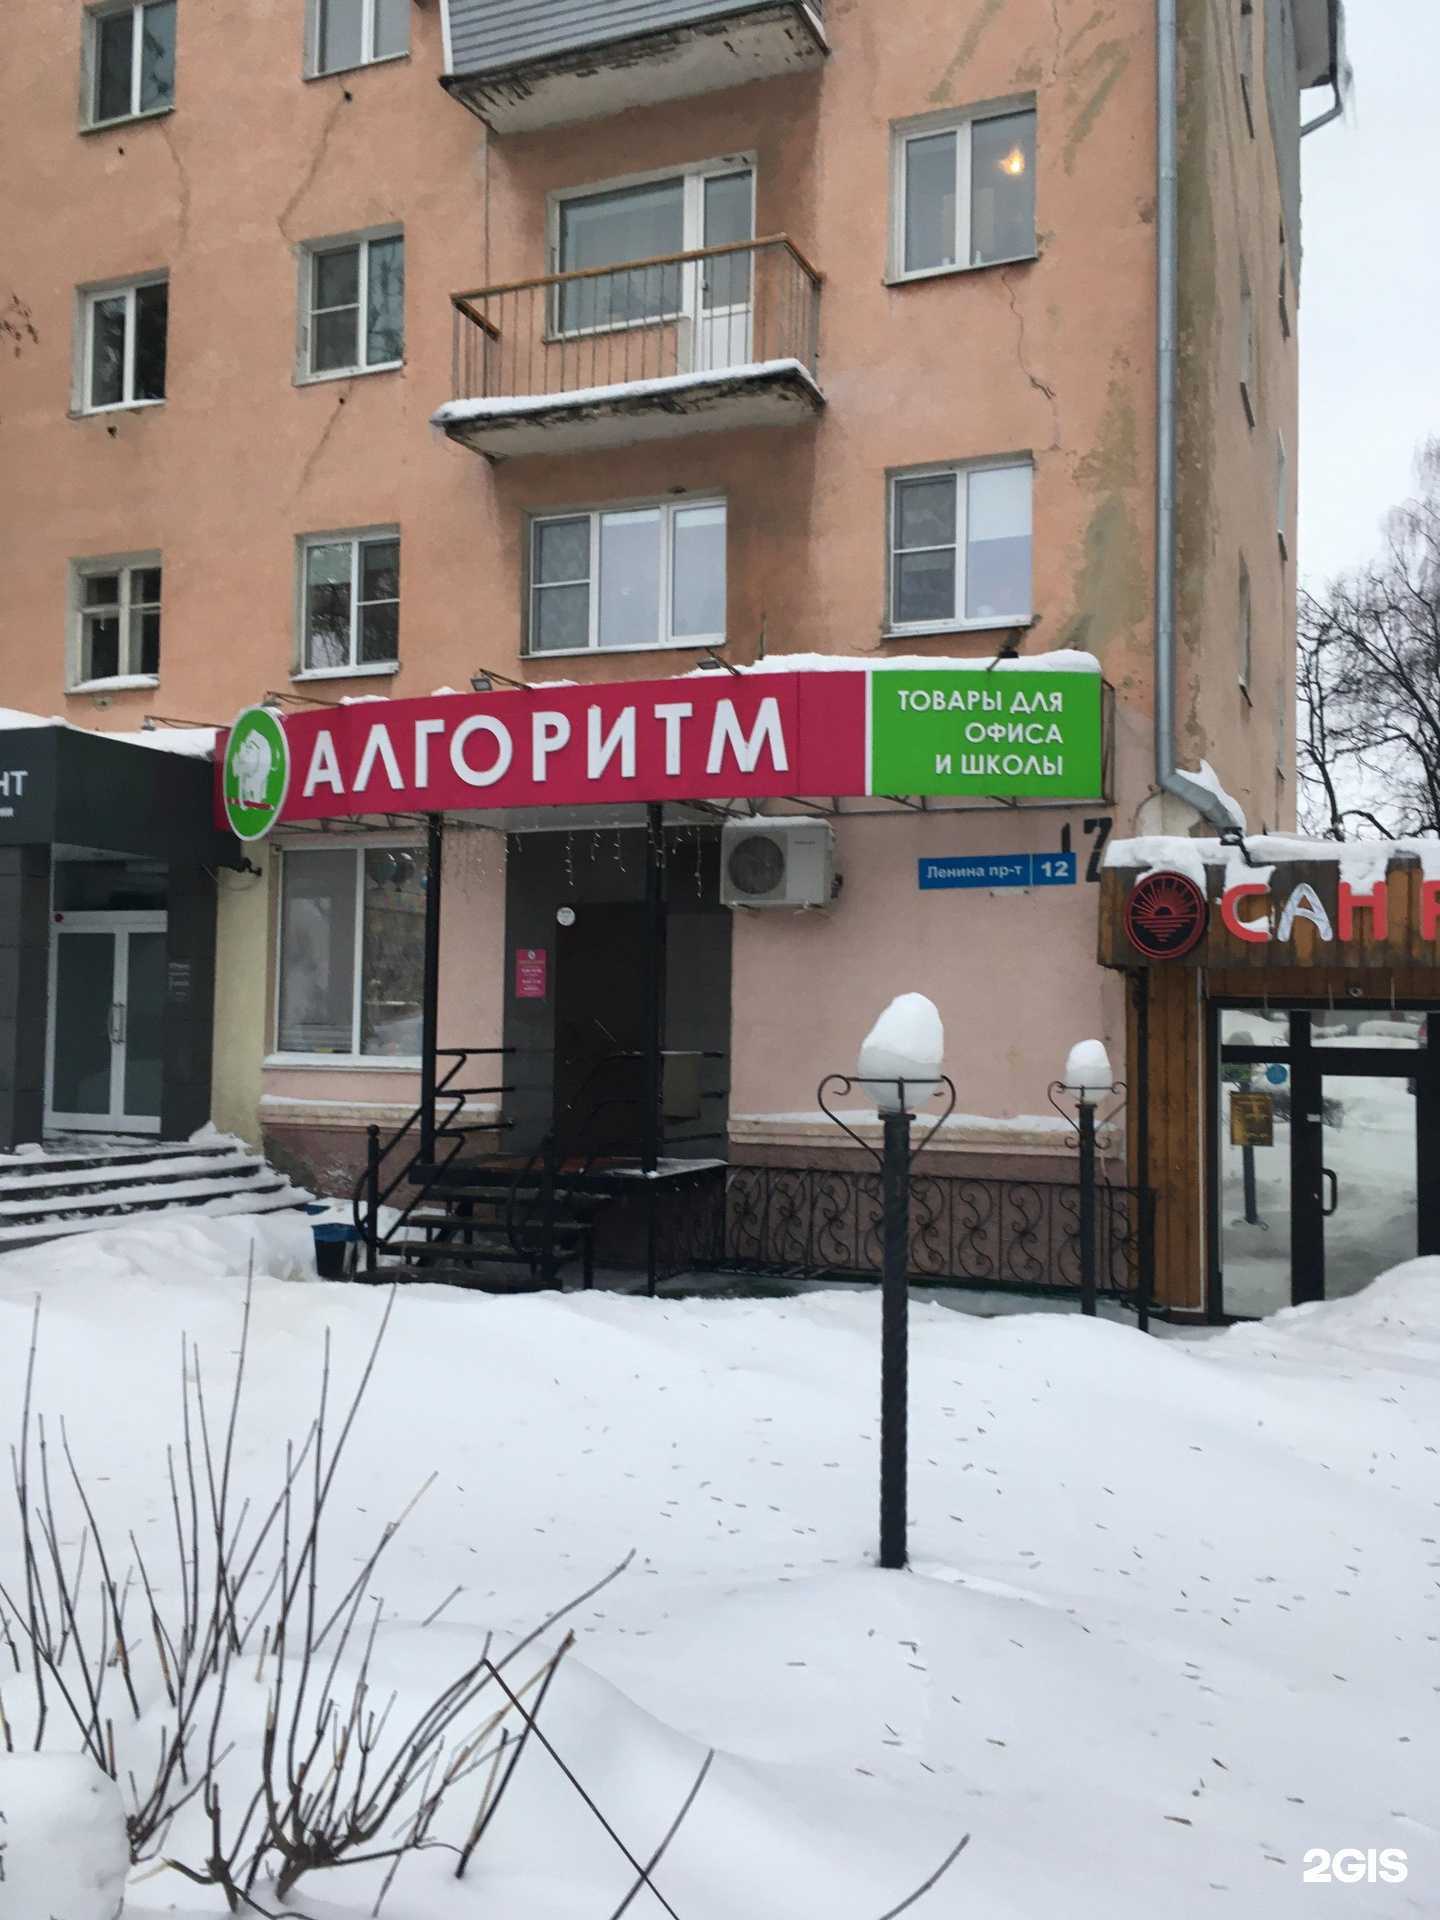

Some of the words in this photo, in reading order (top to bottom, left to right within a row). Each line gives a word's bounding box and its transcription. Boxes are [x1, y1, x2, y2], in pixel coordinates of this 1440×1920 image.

[898, 690, 1002, 712] ТОВАРЫ
[1010, 692, 1063, 714] ДЛЯ
[965, 722, 1063, 744] ОФИСА
[302, 697, 789, 798] АЛГОРИТМ
[935, 755, 952, 775] И
[961, 755, 1063, 776] ШКОЛЫ
[927, 865, 985, 879] Ленина
[989, 864, 1023, 878] пр-т
[1040, 861, 1069, 878] 12
